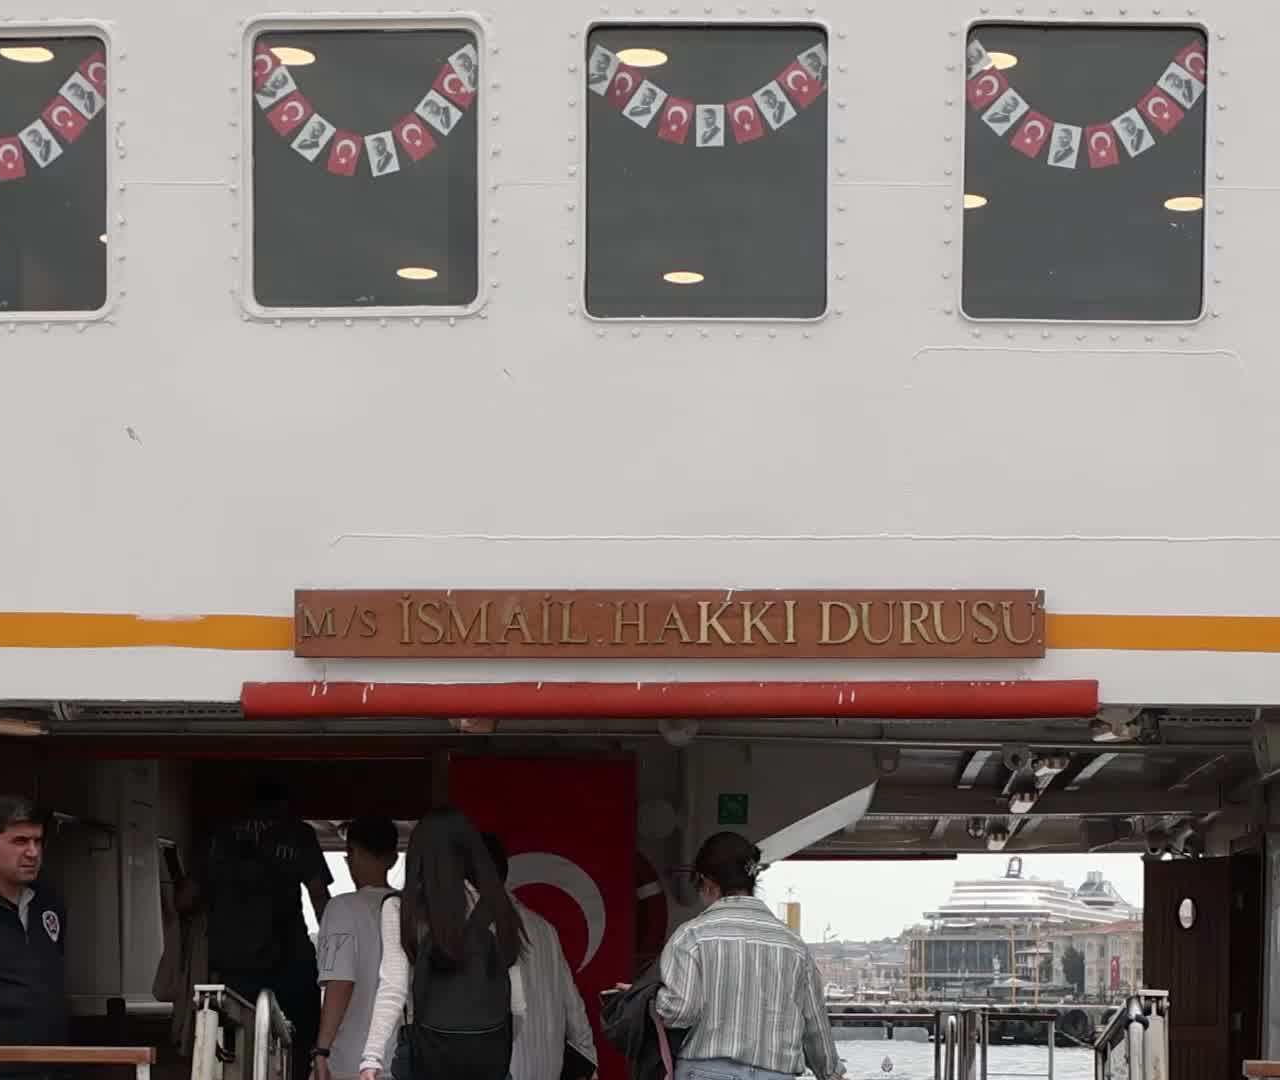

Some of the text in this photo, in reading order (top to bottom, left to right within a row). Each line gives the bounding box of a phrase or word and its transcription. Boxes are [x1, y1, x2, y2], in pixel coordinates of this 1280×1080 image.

[299, 592, 1039, 646] M/S İSMAİL HAKKI DURUSU
